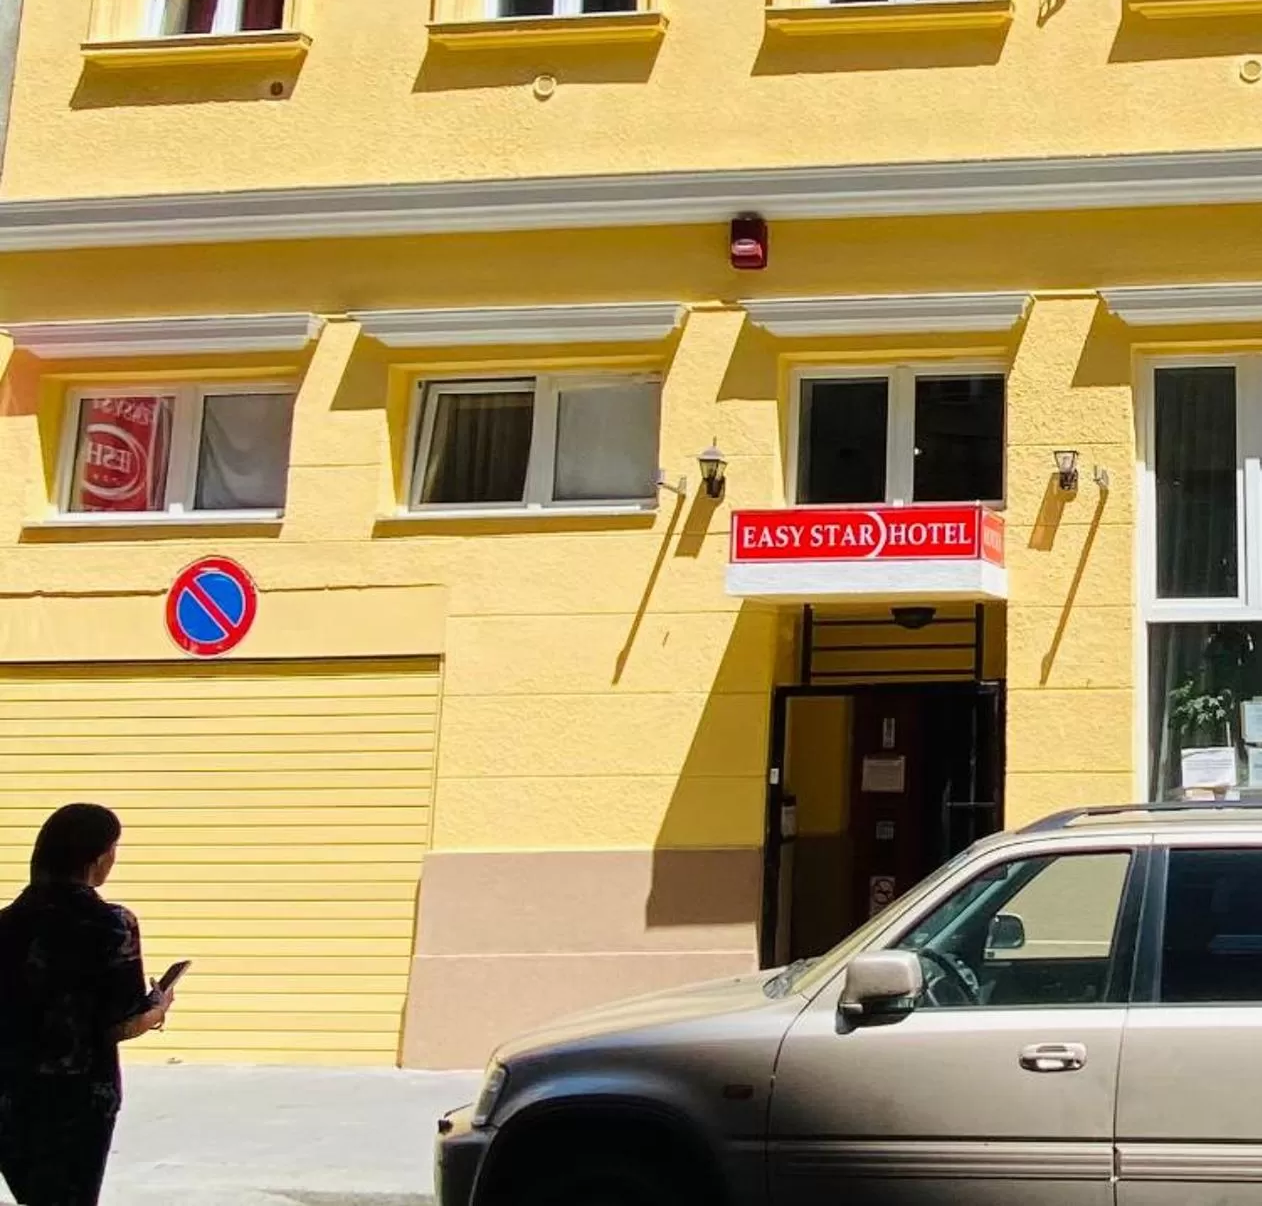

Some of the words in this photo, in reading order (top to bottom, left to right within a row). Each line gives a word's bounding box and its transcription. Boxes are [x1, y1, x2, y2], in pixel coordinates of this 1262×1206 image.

[743, 525, 804, 548] EASY
[810, 524, 875, 547] STAR
[889, 522, 971, 545] HOTEL
